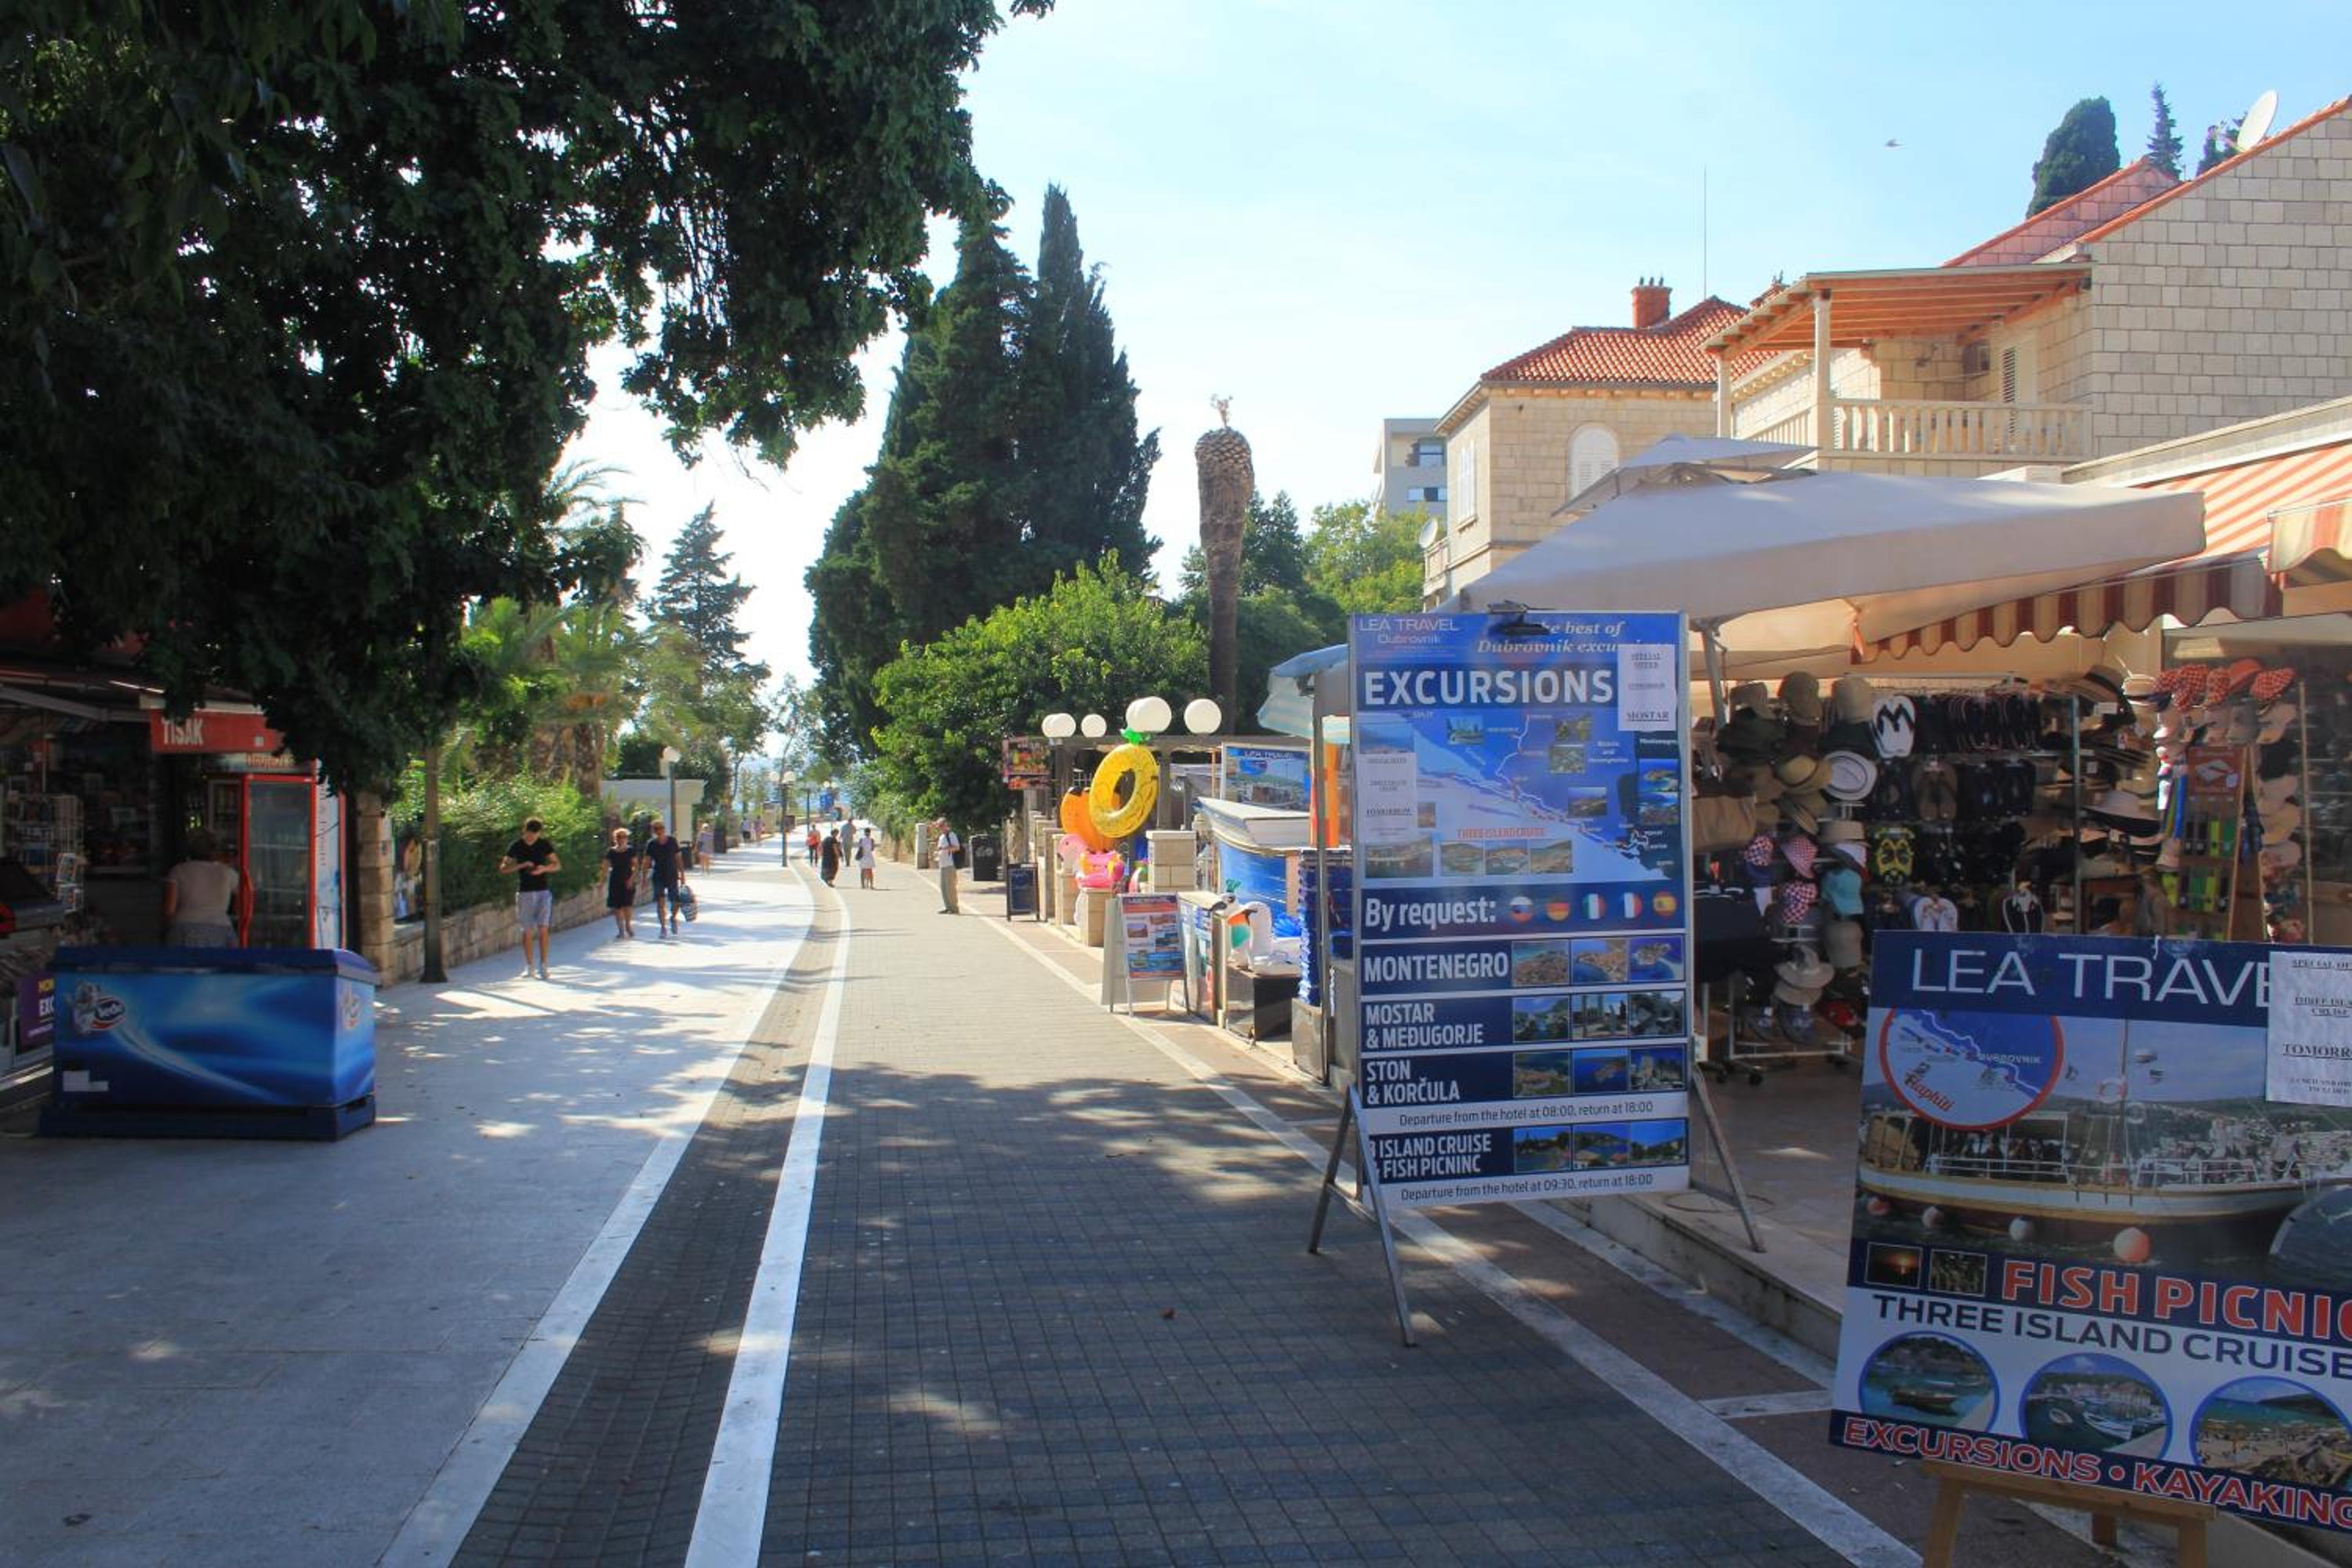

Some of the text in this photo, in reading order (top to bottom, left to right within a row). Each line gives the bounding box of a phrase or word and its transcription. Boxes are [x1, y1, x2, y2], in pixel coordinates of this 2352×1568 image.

[1359, 619, 1459, 631] LEA TRAVEL
[1566, 622, 1601, 634] best
[1606, 622, 1626, 637] of
[1477, 639, 1574, 653] Dubrovnik
[1365, 670, 1613, 705] EXCURSIONS
[161, 716, 204, 745] TISAK
[1365, 896, 1497, 931] By request:
[1364, 952, 1509, 982] MONTENEGRO
[1912, 948, 2036, 996] LEA
[1366, 1003, 1435, 1025] MOSTAR
[1367, 1023, 1484, 1048] & MEĐUGORJE
[2283, 1044, 2352, 1058] TOMORR
[1367, 1059, 1410, 1082] STON
[1367, 1076, 1460, 1105] & KORČULA
[1399, 1112, 1451, 1127] Departure
[1454, 1110, 1479, 1122] from
[1481, 1109, 1498, 1120] the
[1501, 1107, 1527, 1120] hotel
[1529, 1107, 1540, 1118] at
[1579, 1102, 1610, 1115] return
[1612, 1102, 1622, 1114] at
[1624, 1100, 1653, 1113] 18:00
[1380, 1138, 1435, 1158] ISLAND
[1438, 1134, 1492, 1155] CRUISE
[1383, 1157, 1418, 1178] FISH
[1401, 1189, 1453, 1201] Departure
[1456, 1185, 1480, 1197] from
[1483, 1184, 1500, 1194] the
[1501, 1181, 1528, 1193] hotel
[1530, 1181, 1541, 1192] at
[1579, 1178, 1610, 1189] return
[1612, 1177, 1622, 1187] at
[1624, 1173, 1653, 1186] 18:00
[2002, 1259, 2140, 1316] FISH
[1873, 1294, 2352, 1380] THREE ISLAND CRUISE
[1842, 1417, 2102, 1483] EXCURSIONS
